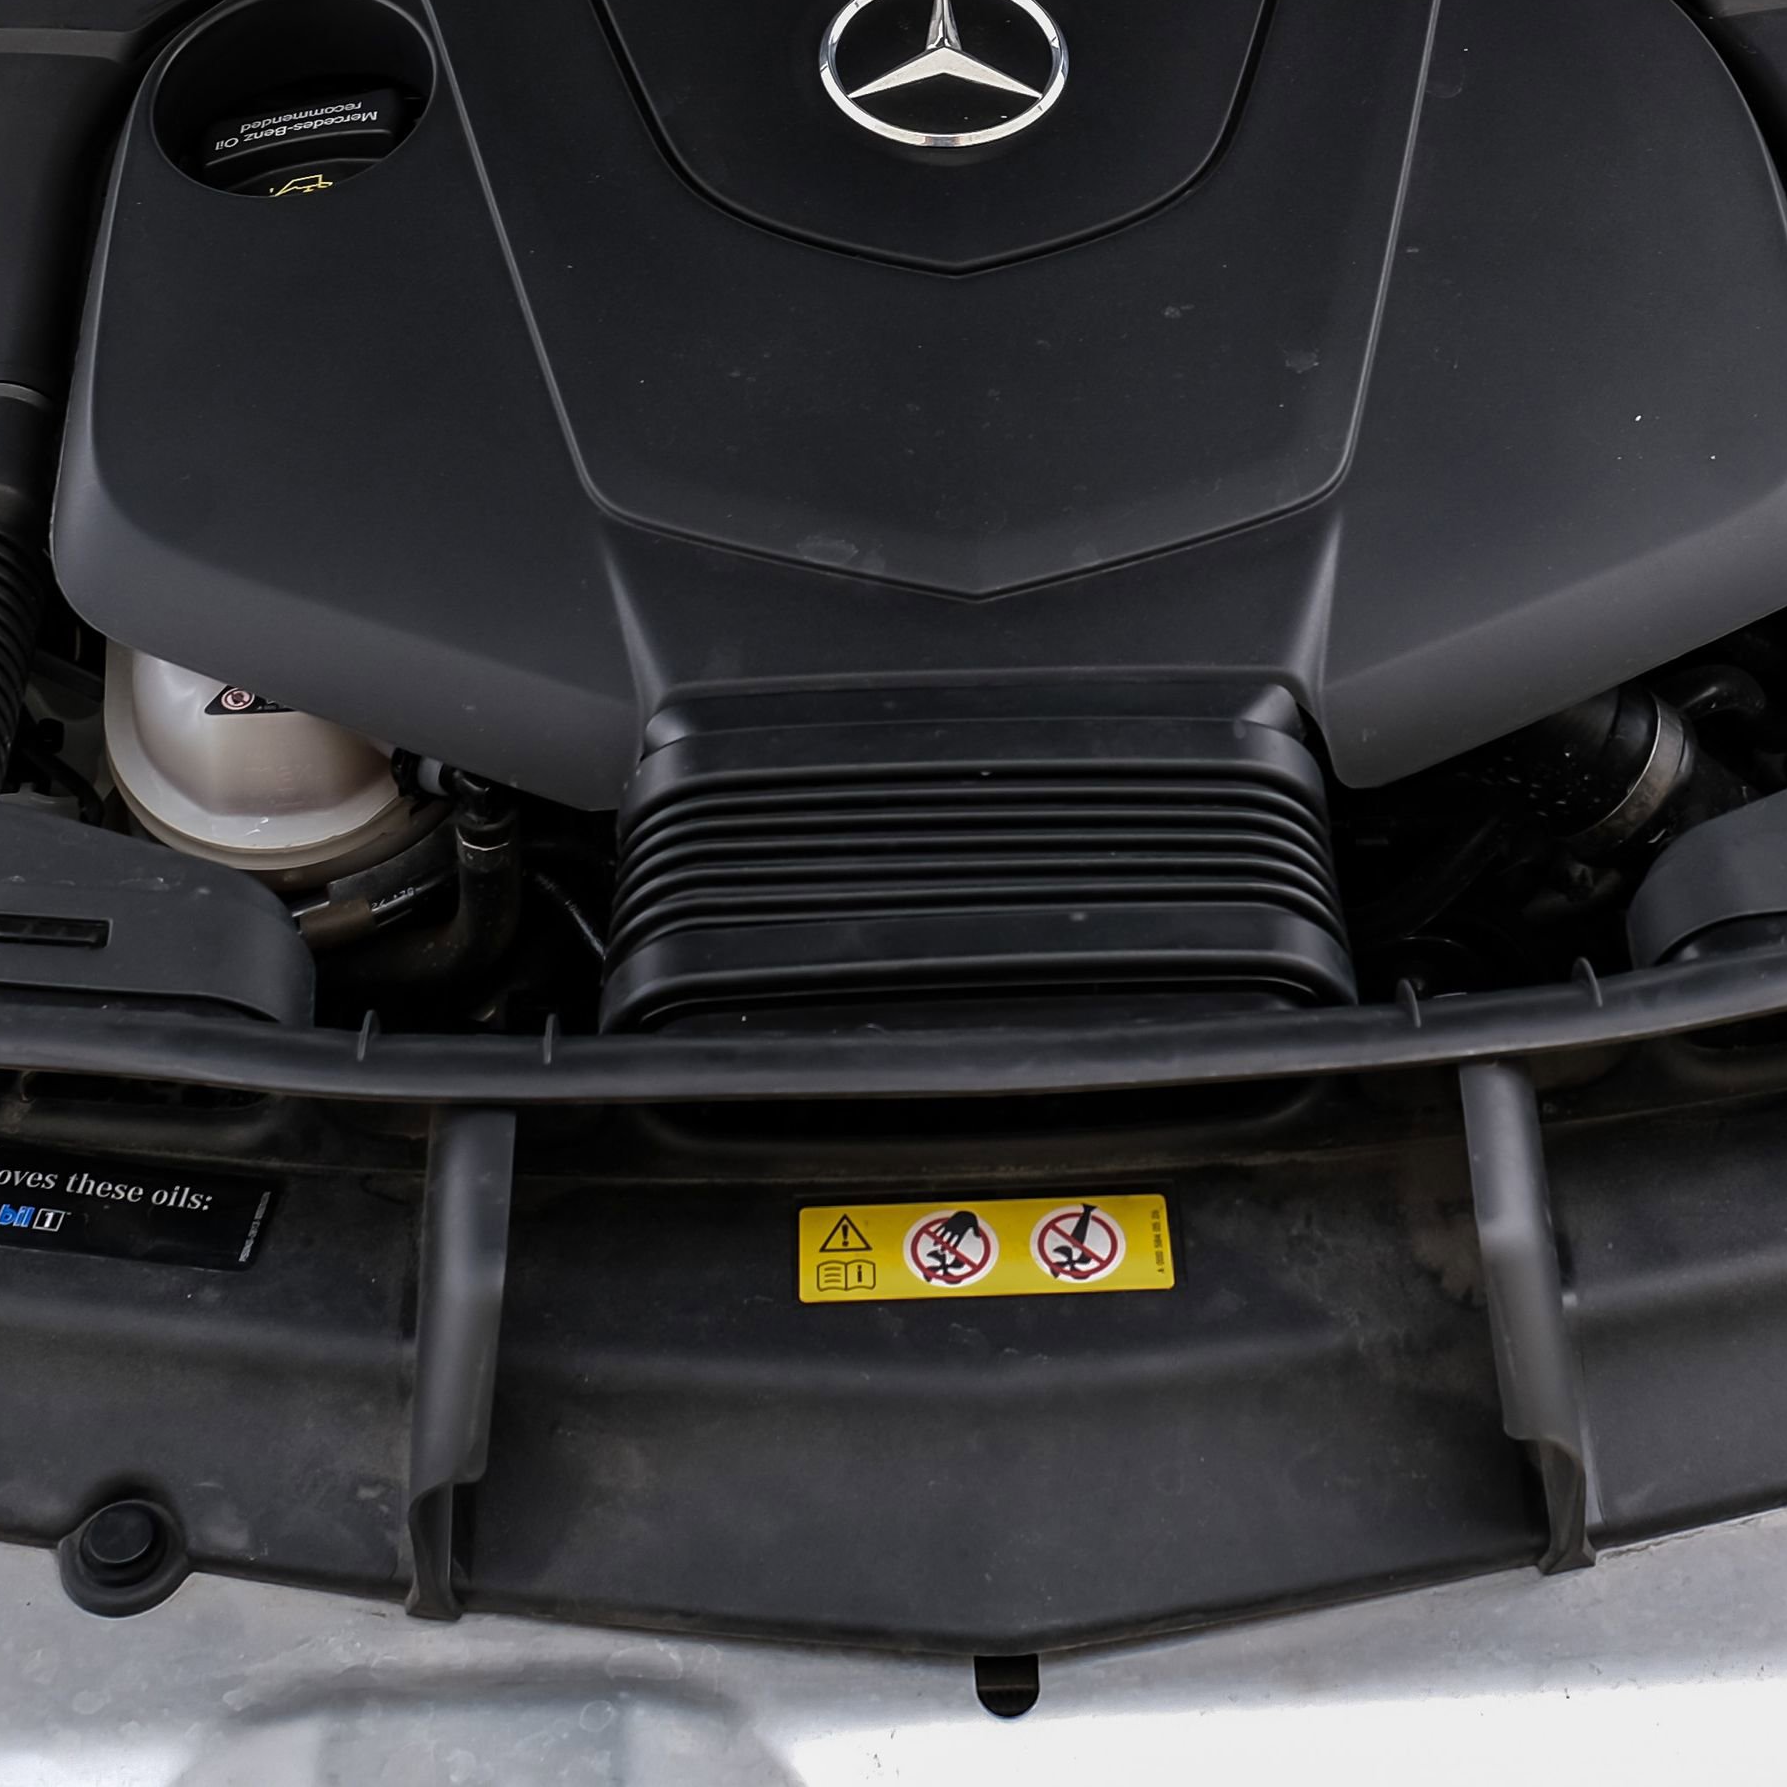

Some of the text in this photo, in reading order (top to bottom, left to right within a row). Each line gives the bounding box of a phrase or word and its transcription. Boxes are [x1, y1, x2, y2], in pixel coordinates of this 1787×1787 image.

[214, 110, 379, 151] Mercedes-Benz Oil
[239, 101, 363, 134] recommended
[64, 1171, 145, 1203] these
[150, 1185, 213, 1211] oils:
